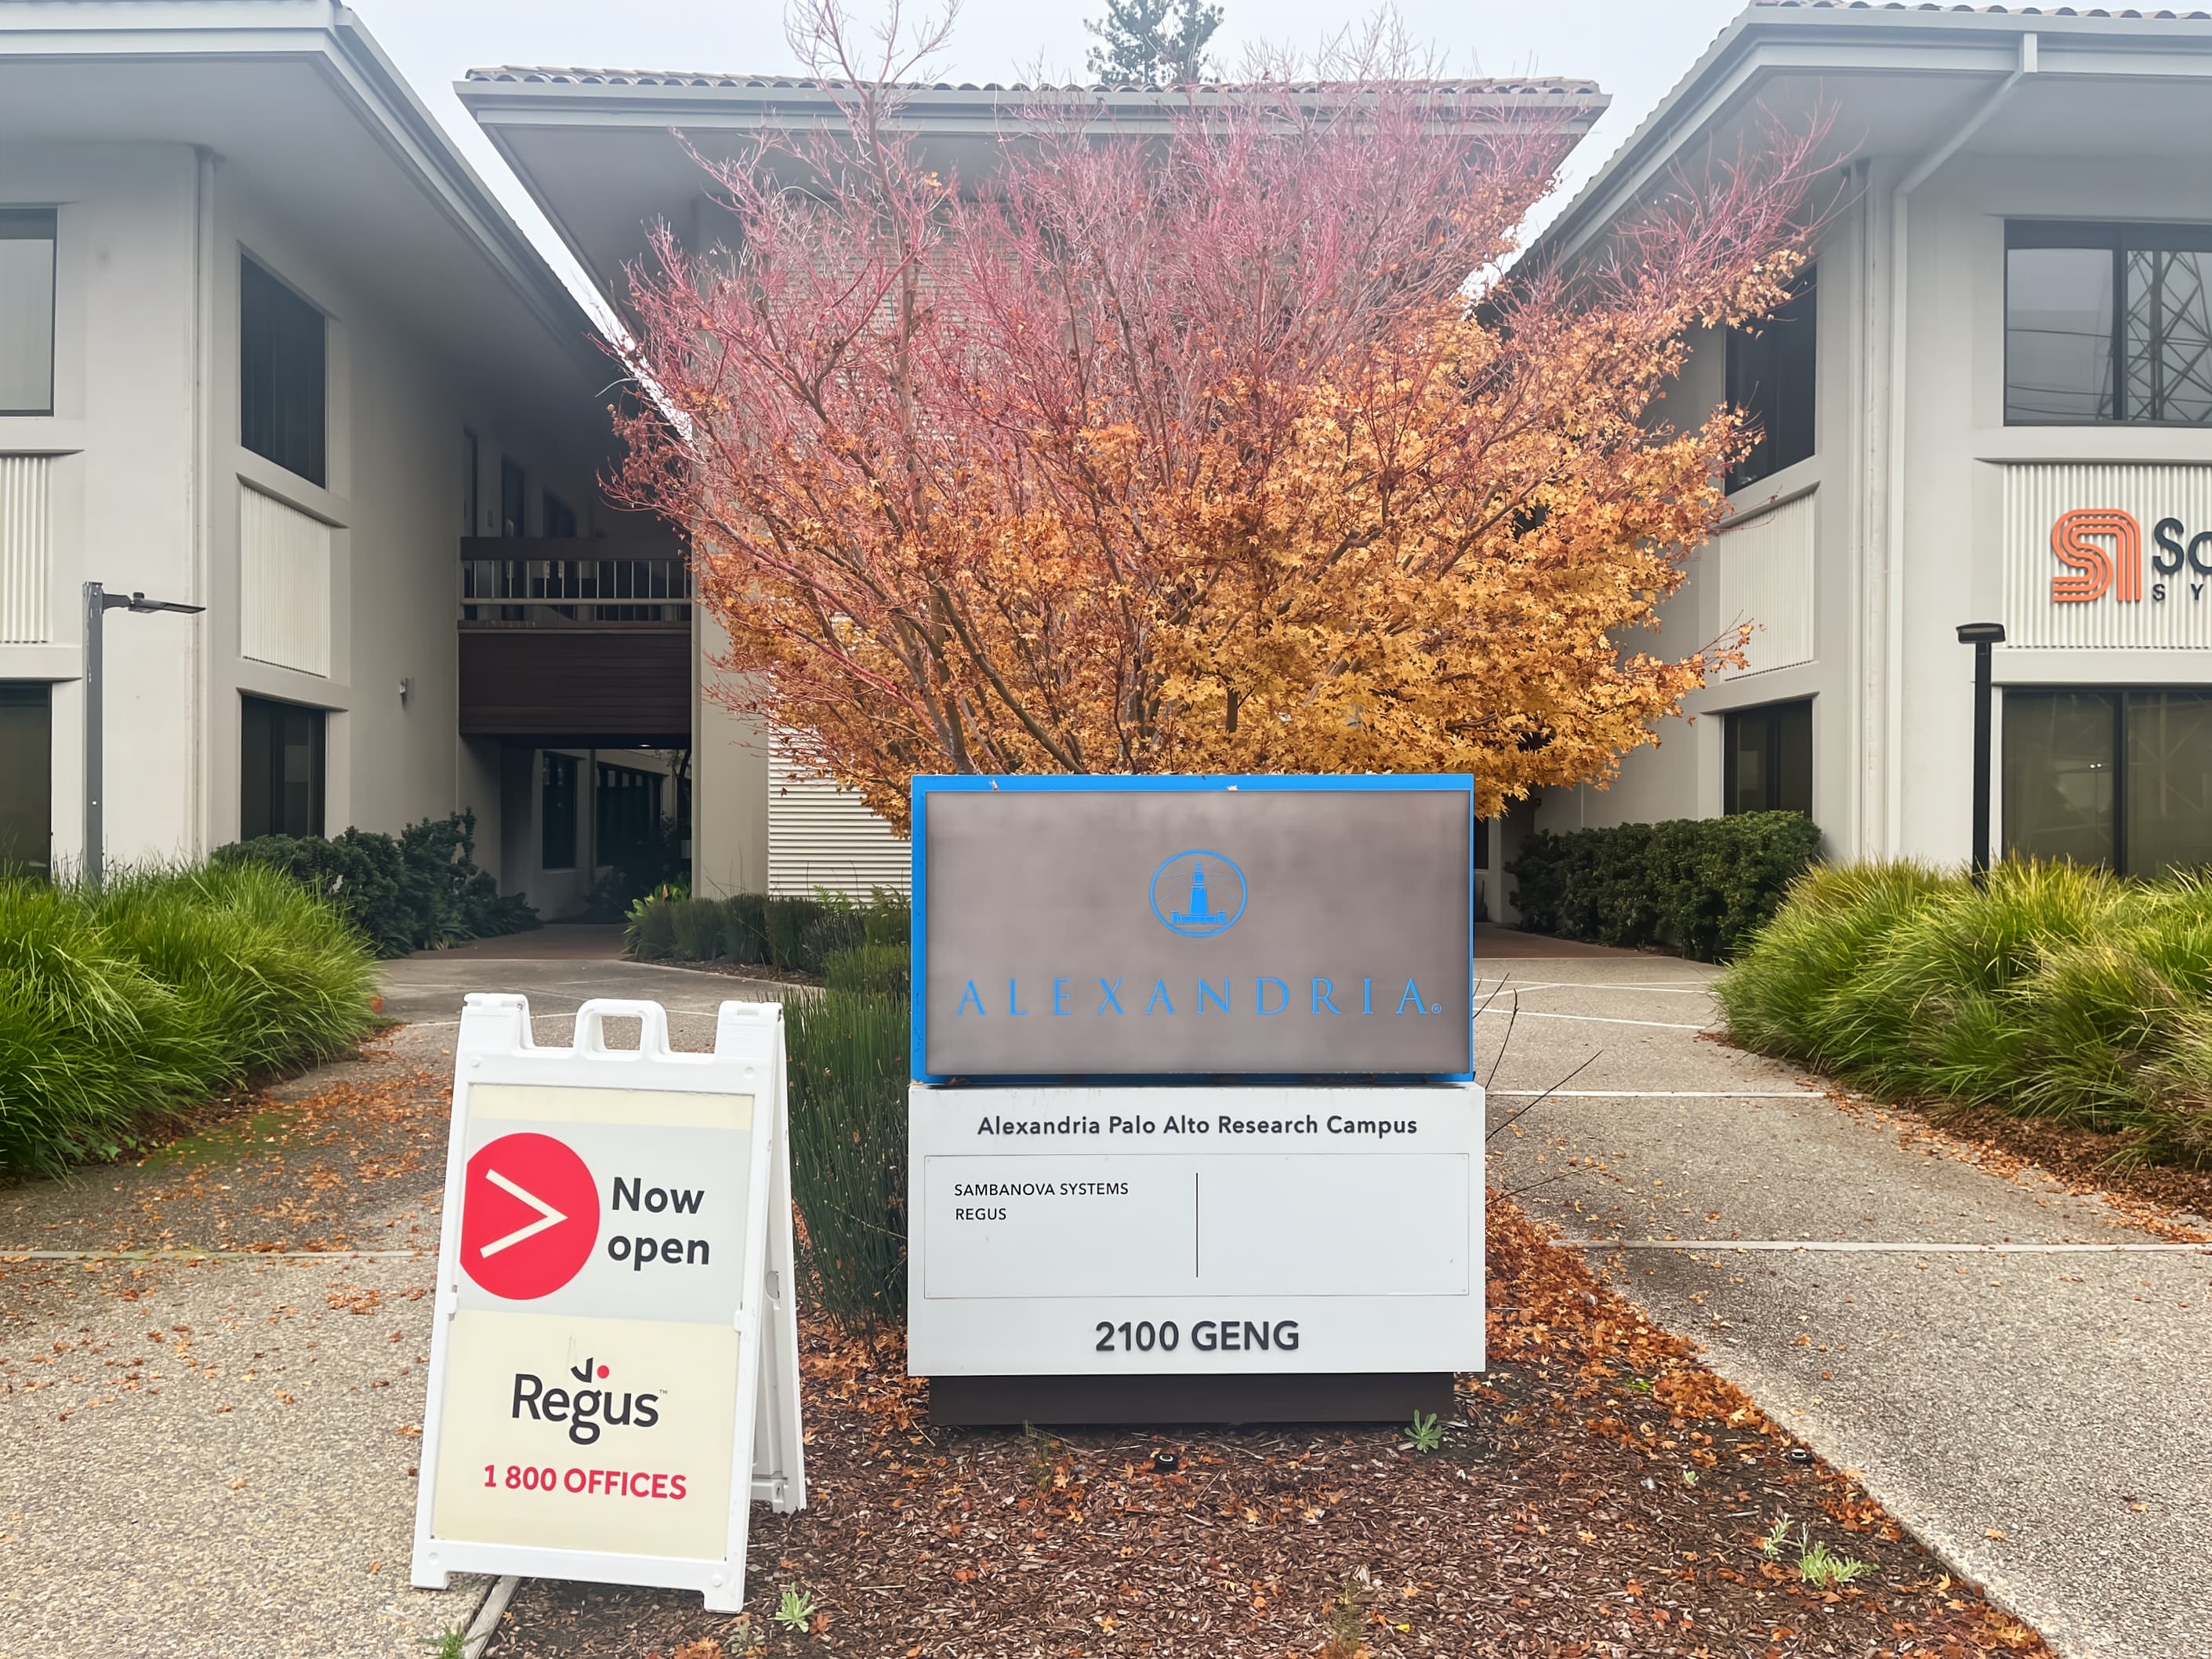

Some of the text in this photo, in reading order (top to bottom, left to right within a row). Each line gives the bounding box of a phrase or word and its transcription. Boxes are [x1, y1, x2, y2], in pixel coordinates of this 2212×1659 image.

[977, 1114, 1418, 1139] Alexandria Palo Alto Research Campus
[611, 1176, 705, 1215] Now
[954, 1182, 1129, 1196] SAMBANOVA SYSTEMS
[955, 1207, 1007, 1222] REGUS
[607, 1233, 710, 1272] open
[1095, 1320, 1300, 1352] 2100 GENG
[483, 1465, 687, 1501] 1 800 OFFICES
